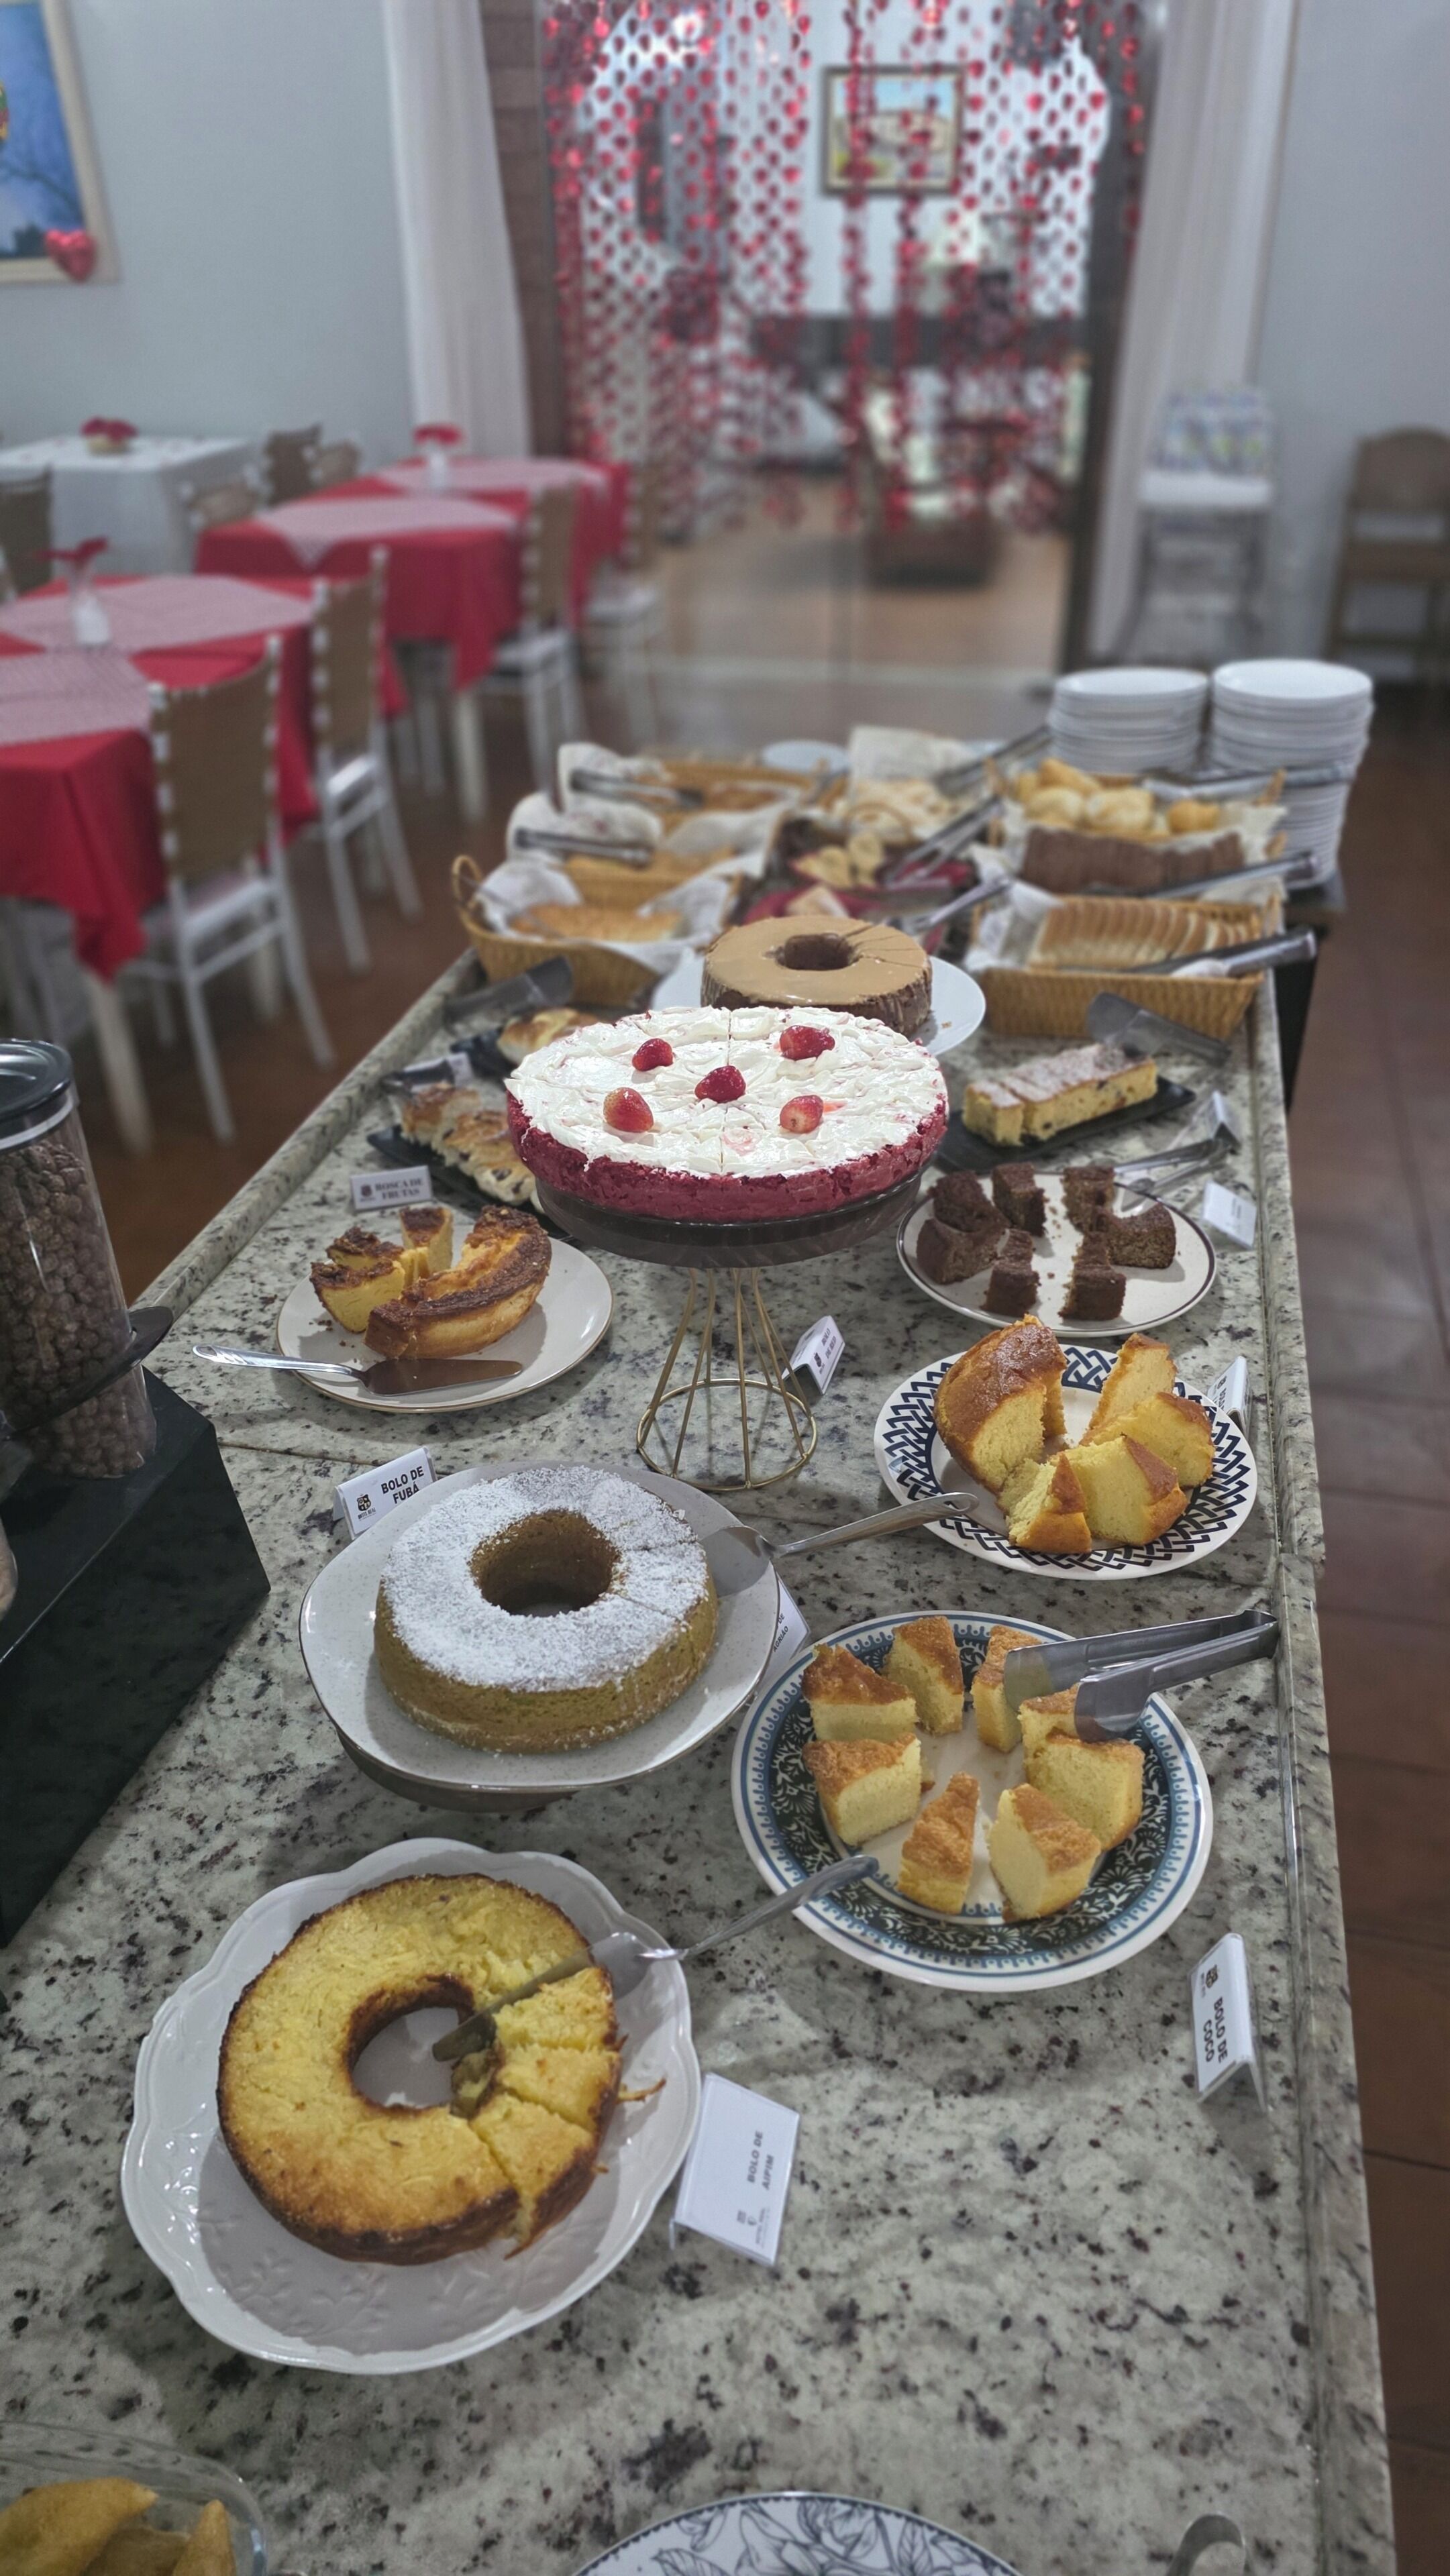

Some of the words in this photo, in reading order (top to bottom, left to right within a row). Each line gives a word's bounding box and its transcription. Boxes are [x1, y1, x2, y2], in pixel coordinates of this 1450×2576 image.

[375, 1180, 408, 1191] ROSCA
[410, 1178, 423, 1186] DE
[382, 1188, 420, 1199] FRUTAS
[381, 1474, 408, 1494] BOLO
[410, 1466, 424, 1481] DE
[393, 1481, 419, 1504] FUBÁ
[778, 1613, 785, 1624] DE
[1214, 1996, 1225, 2038] BOLO
[1203, 2019, 1215, 2063] COCO
[1218, 2039, 1228, 2063] DE
[747, 2149, 760, 2183] BOLO
[754, 2130, 763, 2147] DE
[762, 2154, 774, 2190] AIPIM
